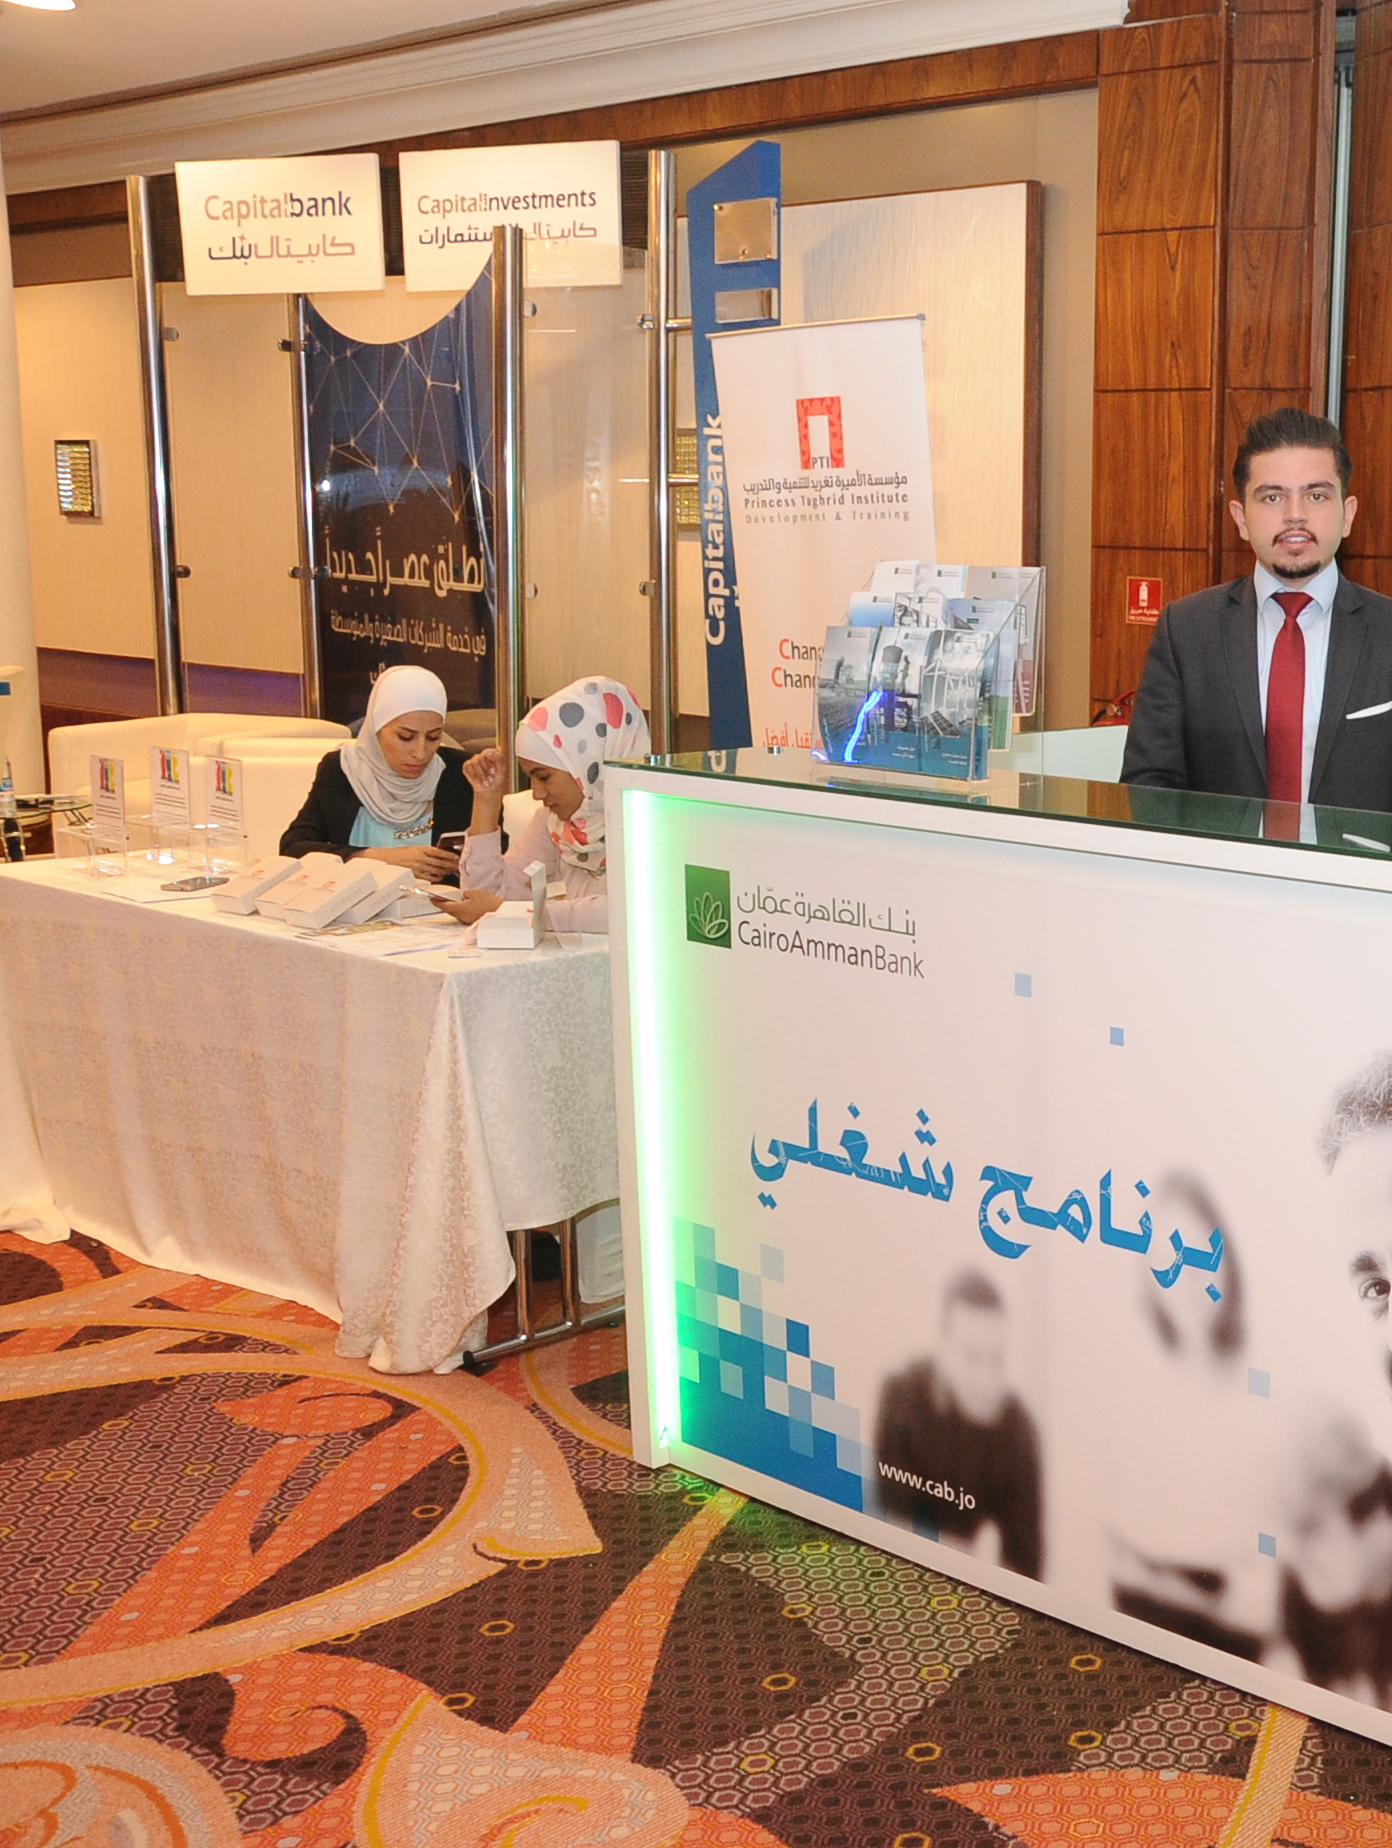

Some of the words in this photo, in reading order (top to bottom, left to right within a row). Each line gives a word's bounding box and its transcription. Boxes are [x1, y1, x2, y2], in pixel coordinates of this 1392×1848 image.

[204, 191, 353, 227] Capitalbank
[417, 189, 597, 219] Capitalinvestments
[811, 456, 830, 469] PTI
[835, 469, 867, 492] الأميرة
[867, 471, 908, 489] مؤسسة
[744, 496, 796, 509] Princess
[800, 493, 845, 509] Taghrid
[851, 492, 908, 505] Institute
[745, 512, 826, 525] Development
[835, 512, 842, 521] &
[852, 509, 909, 522] Training
[703, 414, 730, 646] Capitalbank
[779, 638, 825, 668] Chang
[771, 666, 818, 689] Chan
[794, 891, 867, 928] القاهرة
[868, 906, 916, 944] بنك
[737, 920, 925, 979] CairoAmmanBank
[750, 1097, 955, 1211] شغلي
[978, 1164, 1224, 1304] برنامج
[878, 1461, 976, 1511] www.cab.jo
